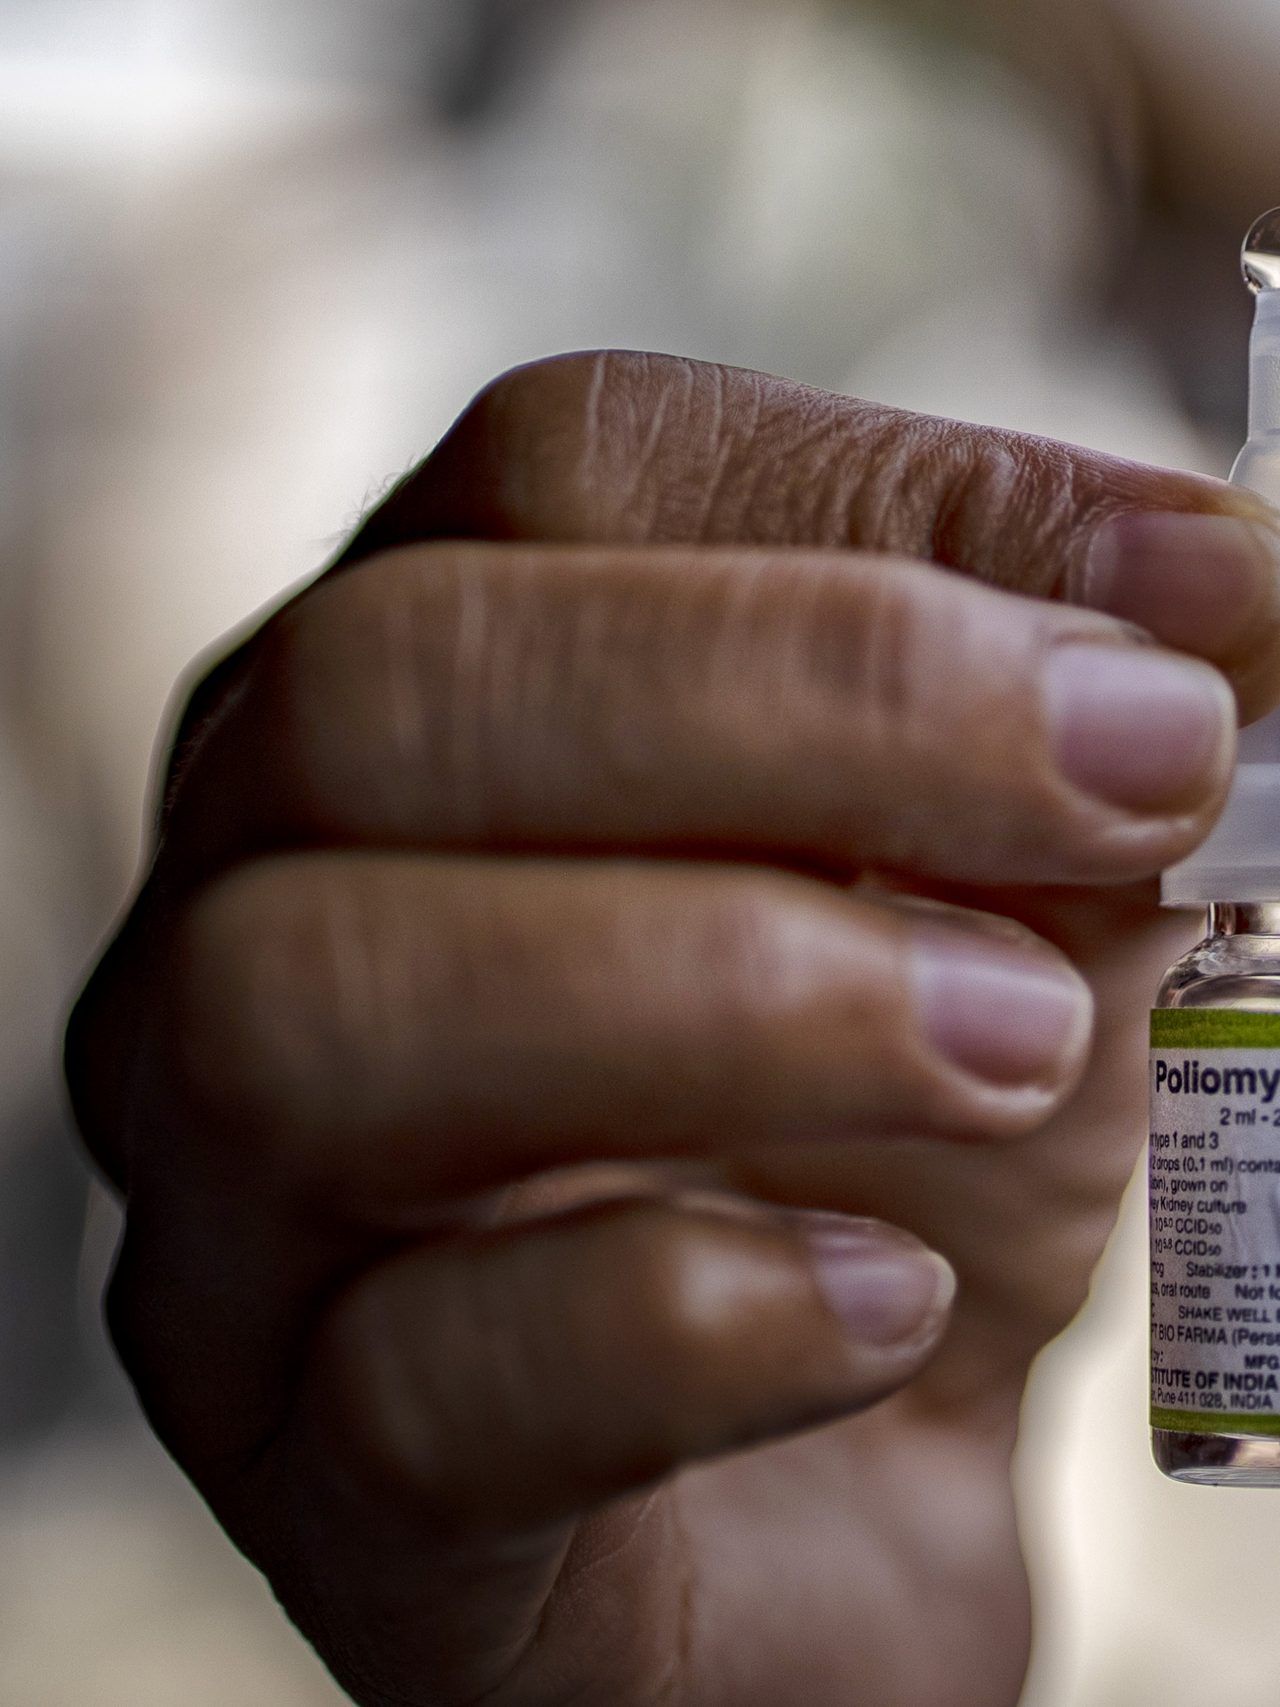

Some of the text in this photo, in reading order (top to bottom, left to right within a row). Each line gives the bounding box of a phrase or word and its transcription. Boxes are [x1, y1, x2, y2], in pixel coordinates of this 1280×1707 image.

[1220, 1108, 1230, 1126] 2
[1236, 1108, 1256, 1125] ml
[1173, 1131, 1178, 1148] 1
[1181, 1131, 1205, 1149] and
[1209, 1131, 1219, 1149] 3
[1157, 1156, 1179, 1173] drops
[1183, 1156, 1205, 1173] (0.1
[1170, 1179, 1206, 1195] grown
[1210, 1180, 1228, 1192] on
[1160, 1196, 1193, 1215] Kidney
[1197, 1200, 1247, 1214] culture
[1186, 1261, 1248, 1279] Stabilizer
[1160, 1281, 1178, 1297] oral
[1180, 1285, 1211, 1299] route
[1235, 1284, 1264, 1300] Not
[1178, 1305, 1222, 1320] SHAKE
[1226, 1308, 1271, 1323] WELL
[1159, 1324, 1175, 1342] BIO
[1177, 1326, 1228, 1345] FARMA
[1195, 1371, 1220, 1390] OF
[1223, 1373, 1279, 1392] INDIA
[1230, 1393, 1273, 1410] INDIA
